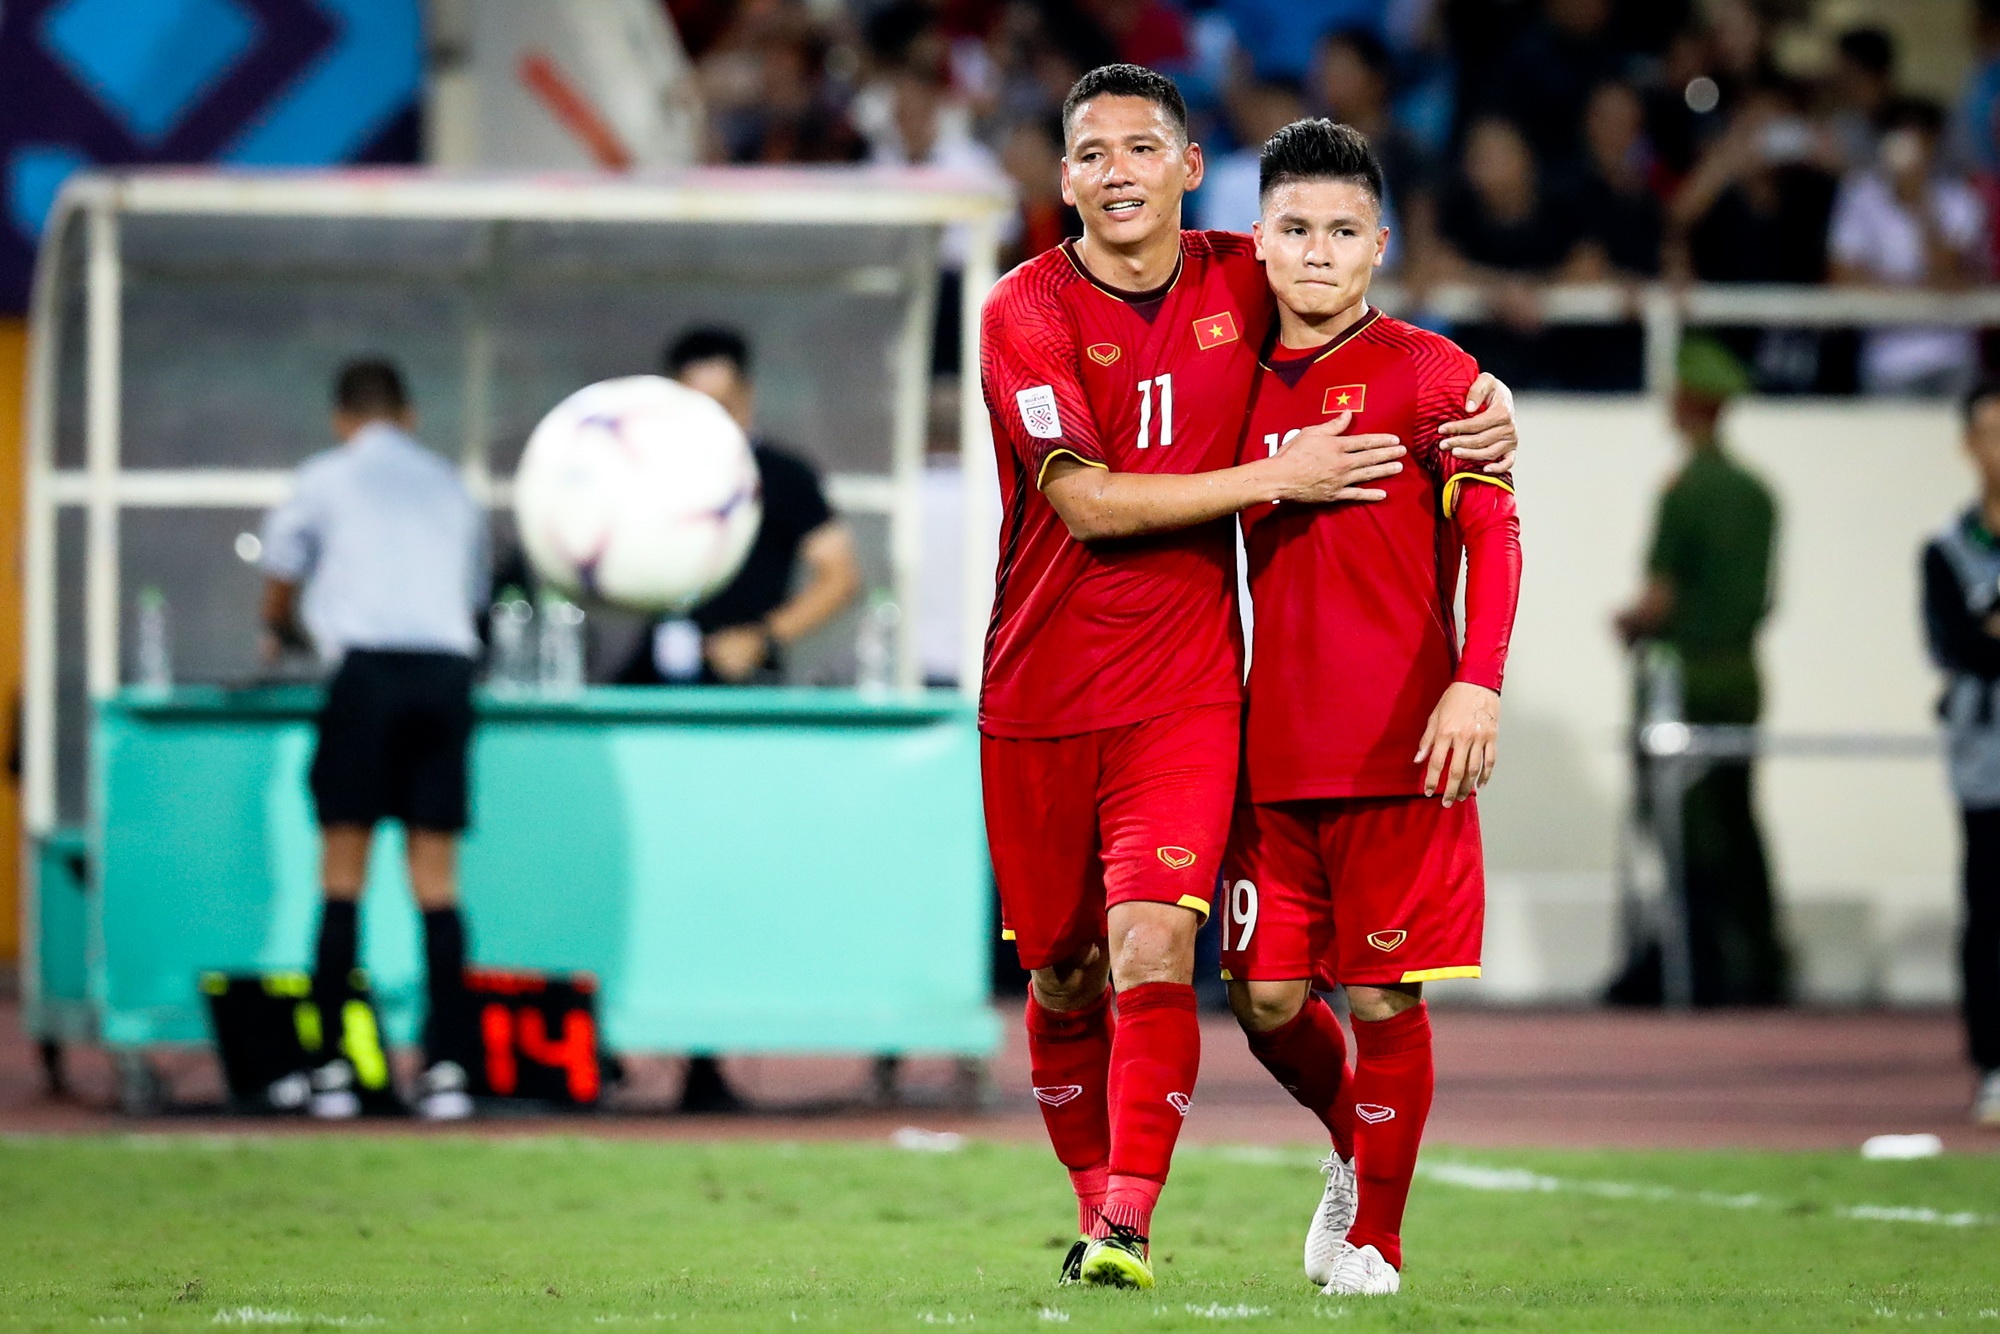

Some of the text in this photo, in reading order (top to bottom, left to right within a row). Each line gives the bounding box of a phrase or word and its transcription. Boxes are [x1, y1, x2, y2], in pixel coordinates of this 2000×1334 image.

[1137, 373, 1173, 449] 11
[1222, 879, 1258, 951] 19
[481, 1003, 600, 1101] 14
